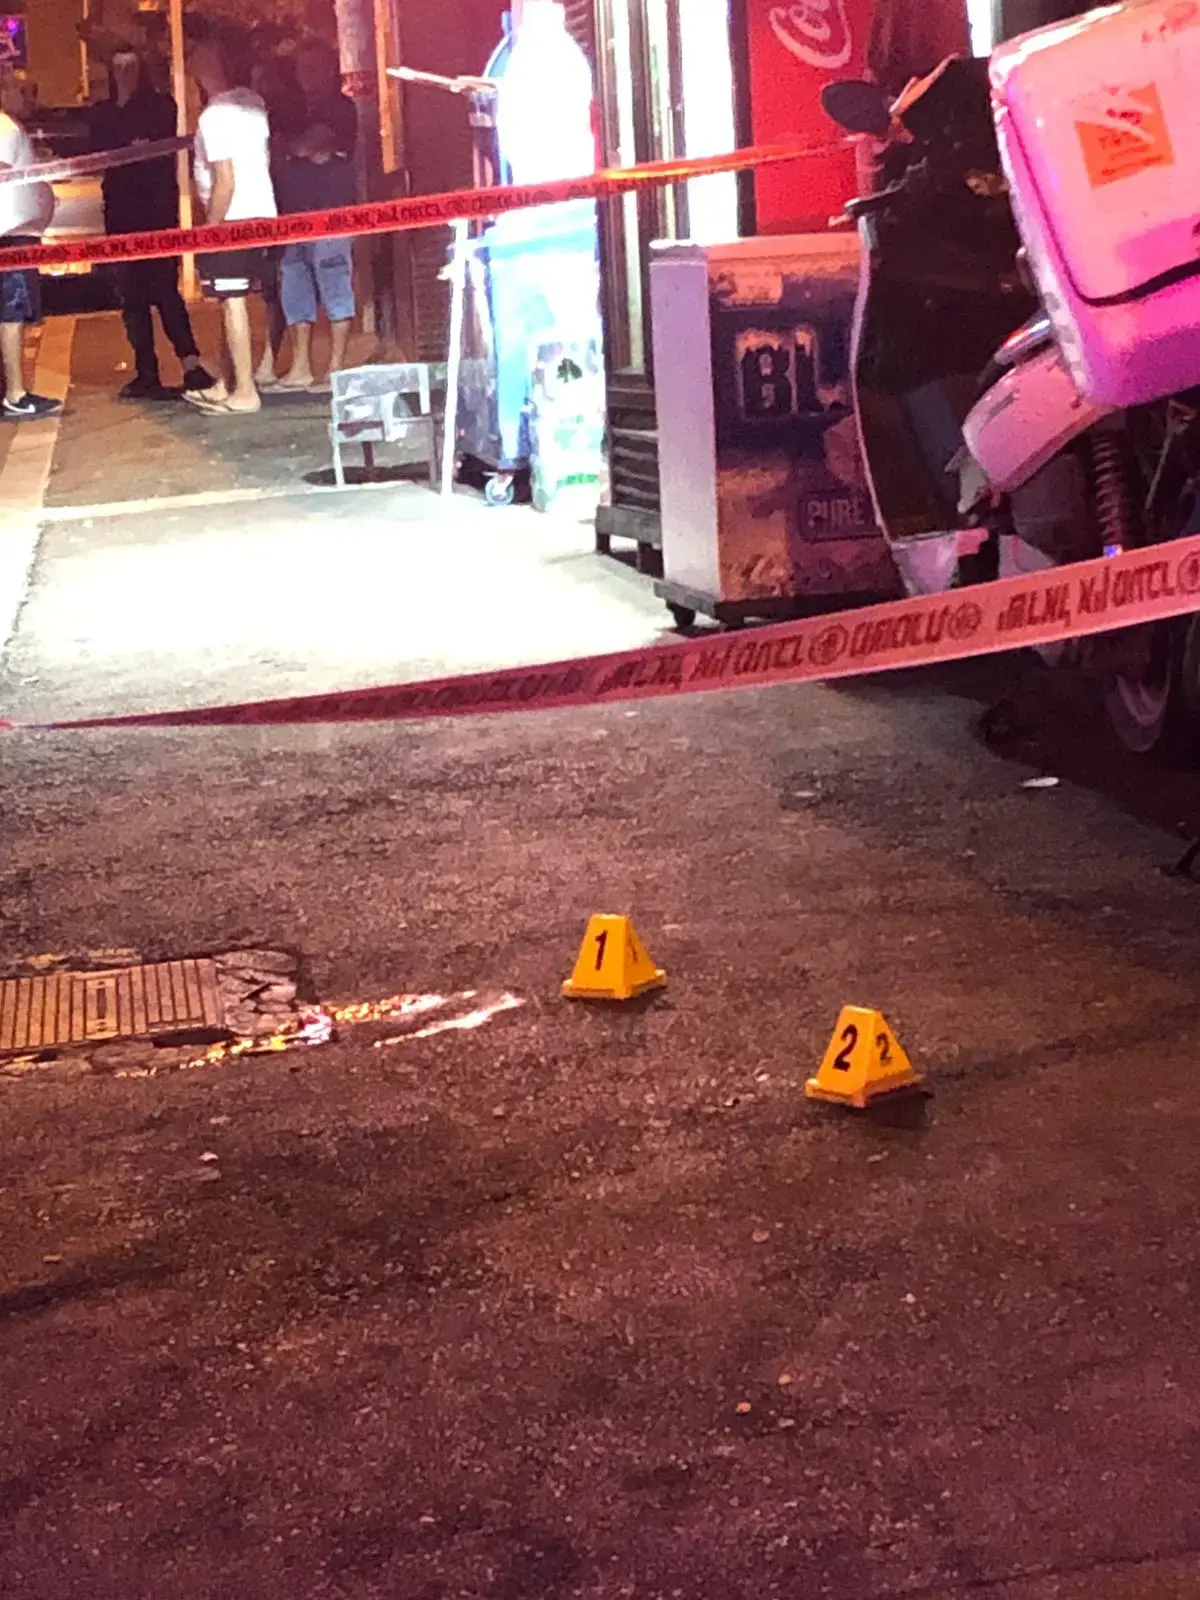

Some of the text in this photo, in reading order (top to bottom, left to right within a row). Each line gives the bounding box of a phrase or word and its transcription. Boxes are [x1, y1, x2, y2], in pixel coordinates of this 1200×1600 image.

[807, 499, 866, 529] PURE
[996, 583, 1071, 632] ישראל
[1078, 565, 1110, 616] אין
[1111, 560, 1176, 608] מעבר
[594, 929, 608, 970] 1
[833, 1024, 858, 1072] 2
[874, 1033, 892, 1066] 2
